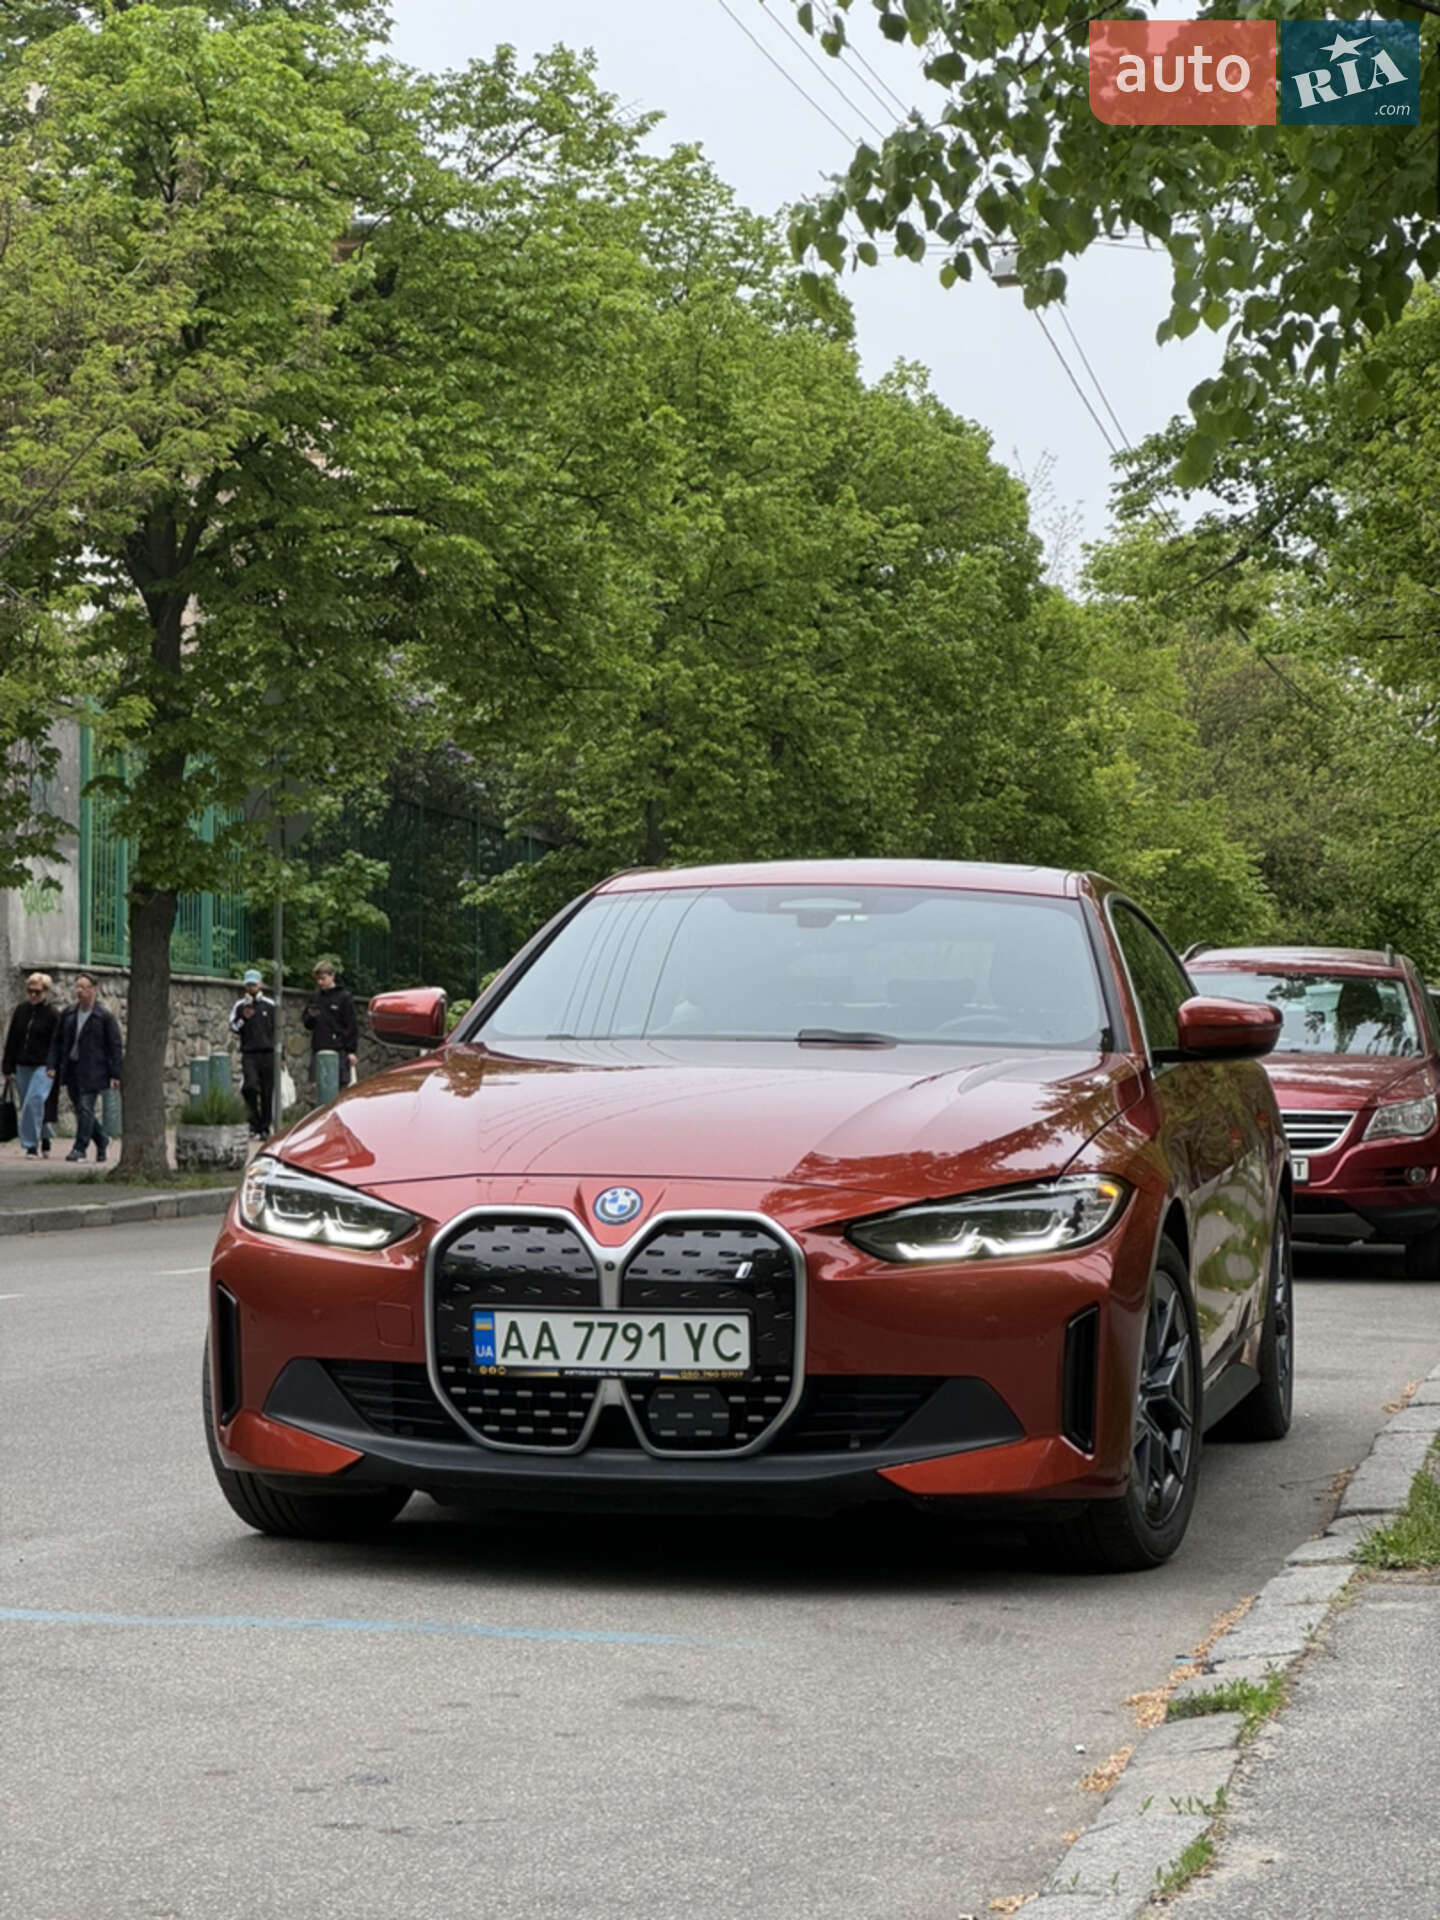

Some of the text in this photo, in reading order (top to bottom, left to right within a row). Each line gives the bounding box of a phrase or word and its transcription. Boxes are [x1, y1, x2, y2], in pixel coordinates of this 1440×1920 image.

[475, 1344, 494, 1358] UA
[501, 1320, 742, 1362] AA 7791 YC
